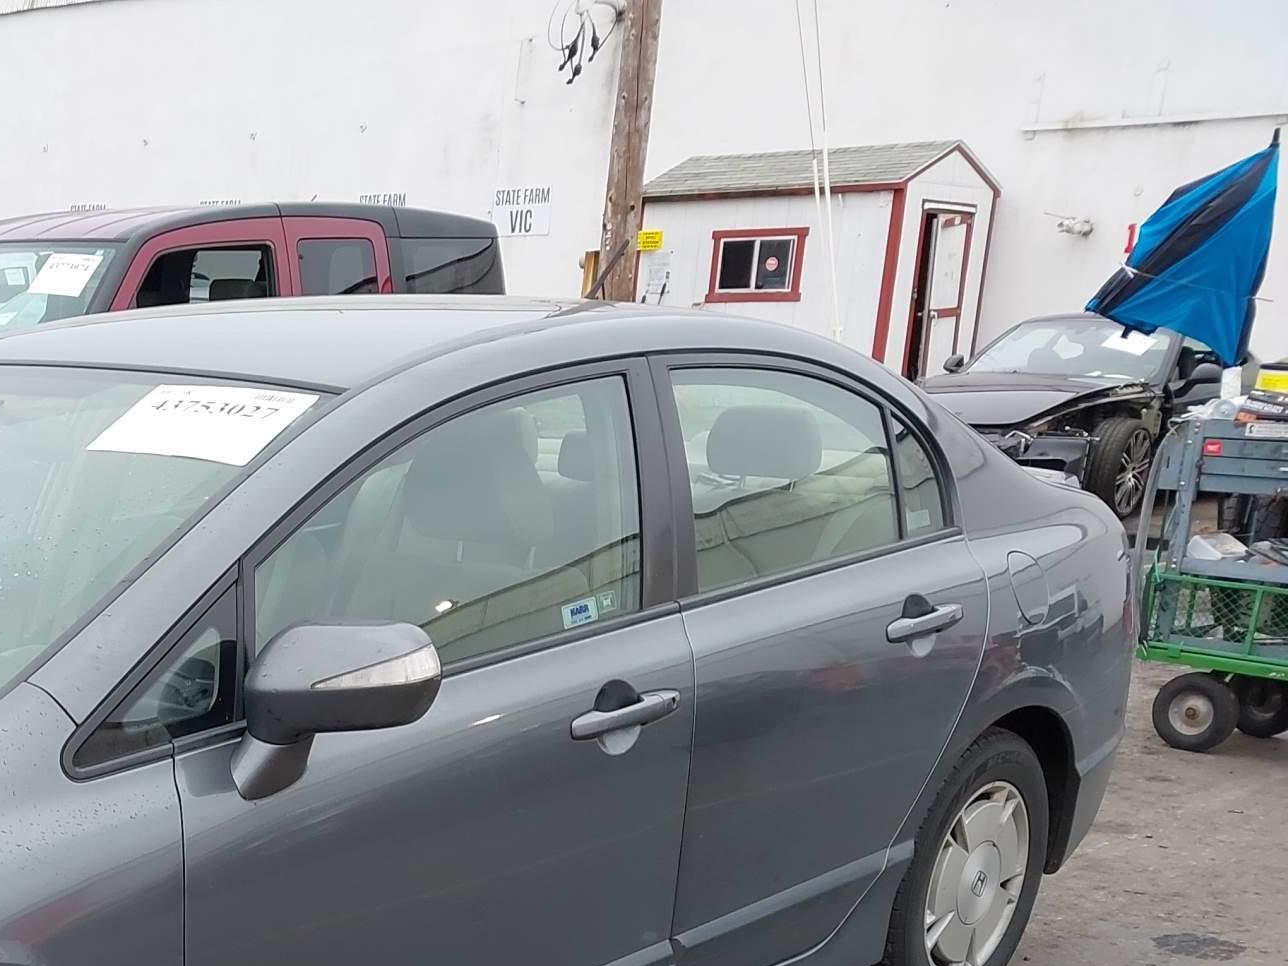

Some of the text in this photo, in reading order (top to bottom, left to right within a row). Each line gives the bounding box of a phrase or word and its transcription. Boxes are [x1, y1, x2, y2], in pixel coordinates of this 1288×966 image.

[495, 186, 551, 207] STATE FARM
[509, 208, 533, 234] VIC
[151, 398, 280, 420] 43753027
